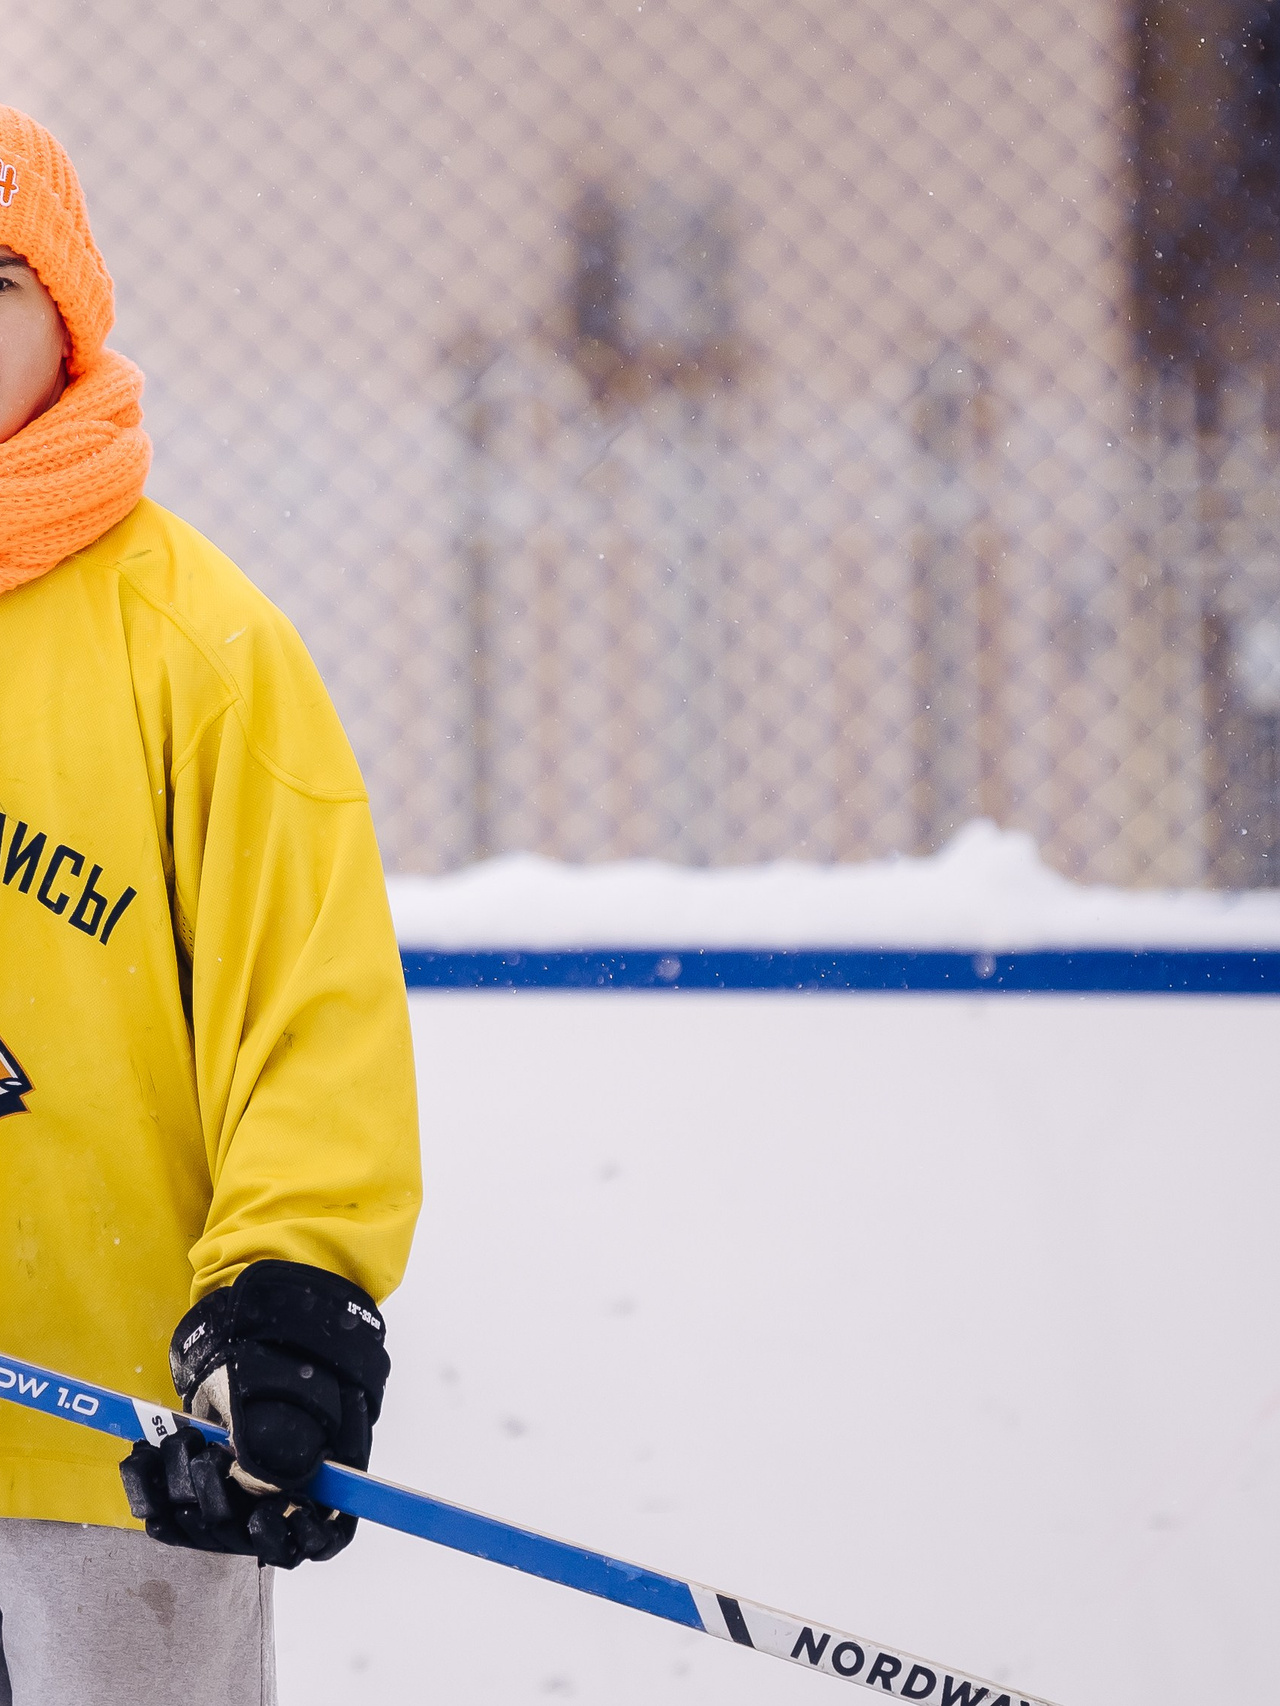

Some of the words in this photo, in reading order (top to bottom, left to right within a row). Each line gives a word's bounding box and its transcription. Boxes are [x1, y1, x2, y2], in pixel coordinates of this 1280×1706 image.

[183, 1321, 206, 1354] STEX
[57, 1386, 99, 1416] 1.0
[789, 1626, 1031, 1706] NORDW
